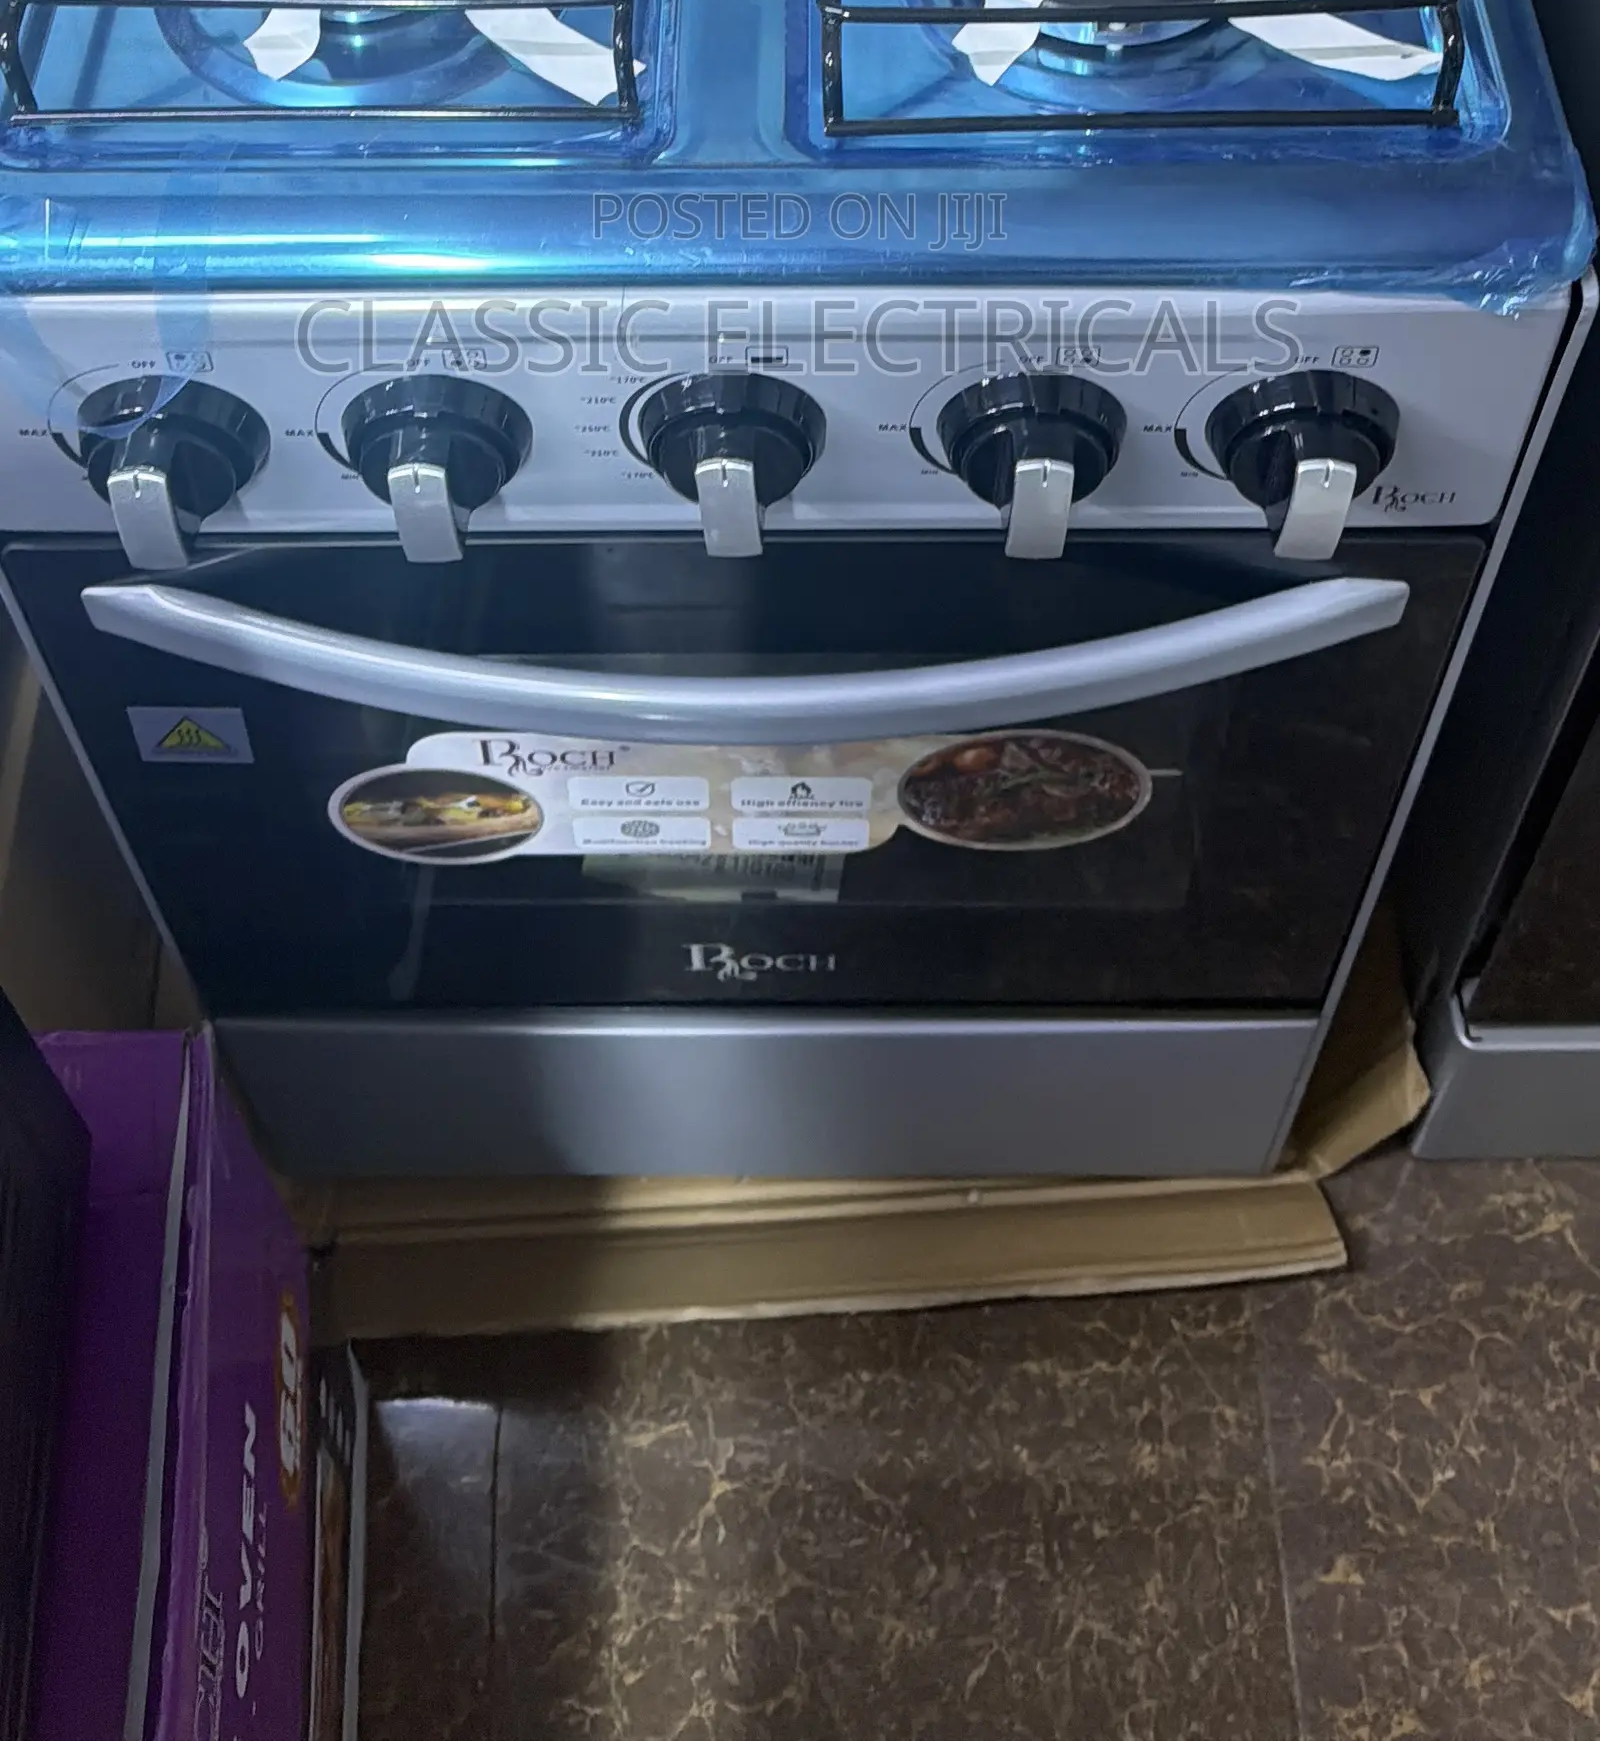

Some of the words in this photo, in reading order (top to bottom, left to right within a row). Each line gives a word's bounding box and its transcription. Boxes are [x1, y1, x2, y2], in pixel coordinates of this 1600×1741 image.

[878, 423, 907, 432] MAX
[1142, 424, 1173, 433] MAX
[1371, 485, 1456, 512] ROCH
[474, 738, 616, 777] ROCH
[681, 942, 836, 982] ROCH
[236, 1401, 256, 1699] OVEN
